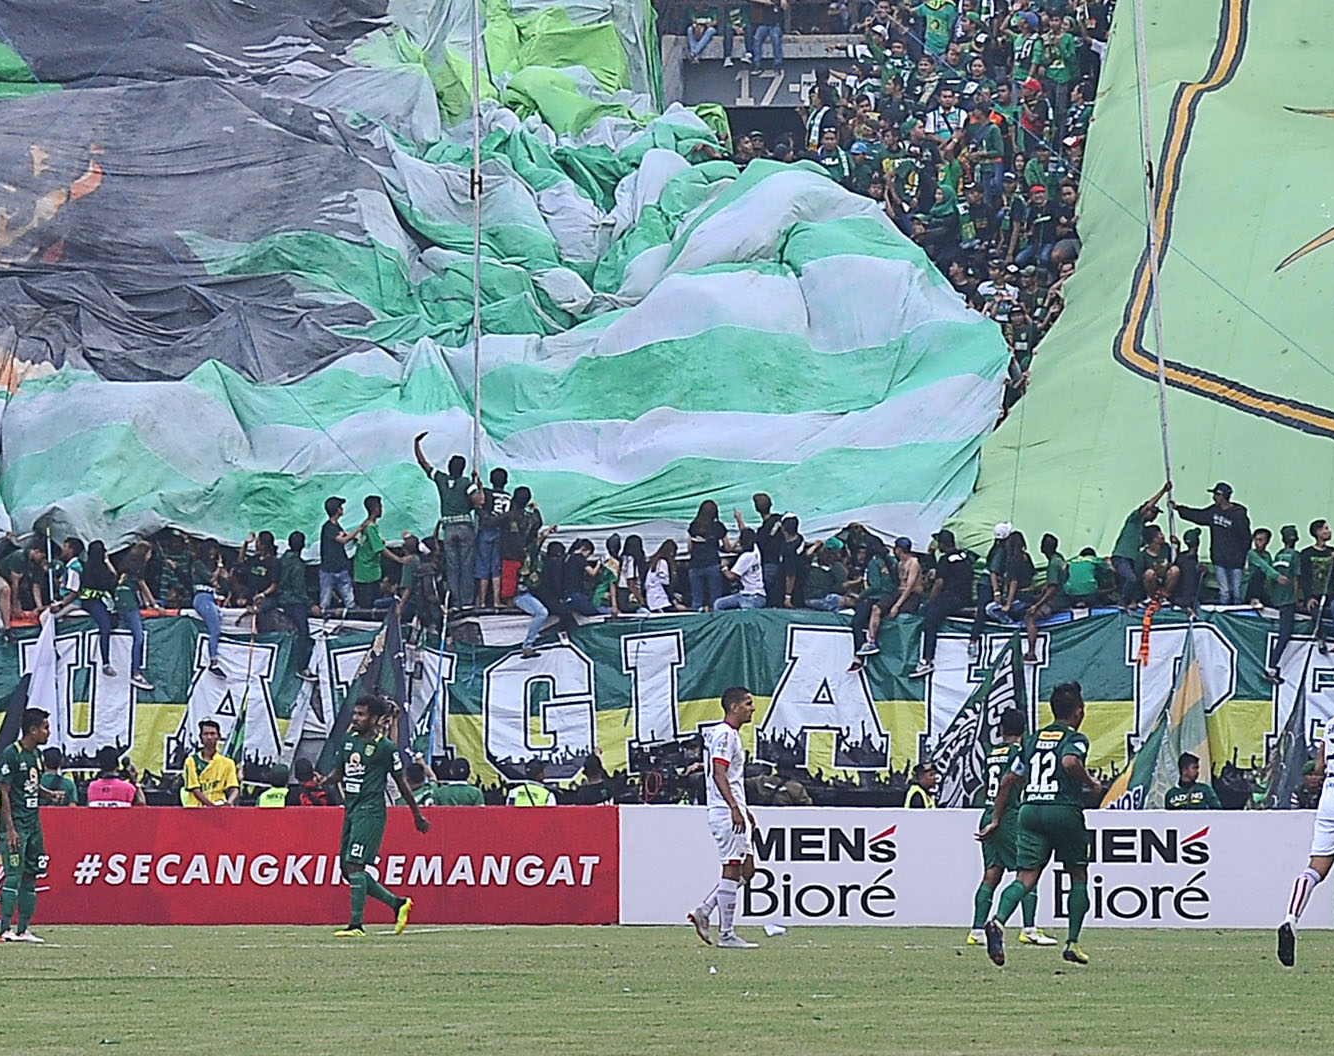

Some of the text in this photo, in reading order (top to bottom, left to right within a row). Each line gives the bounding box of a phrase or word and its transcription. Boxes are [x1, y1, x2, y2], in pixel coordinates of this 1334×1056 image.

[1025, 750, 1060, 794] 12
[350, 843, 365, 858] 21
[740, 868, 898, 919] Bioré
